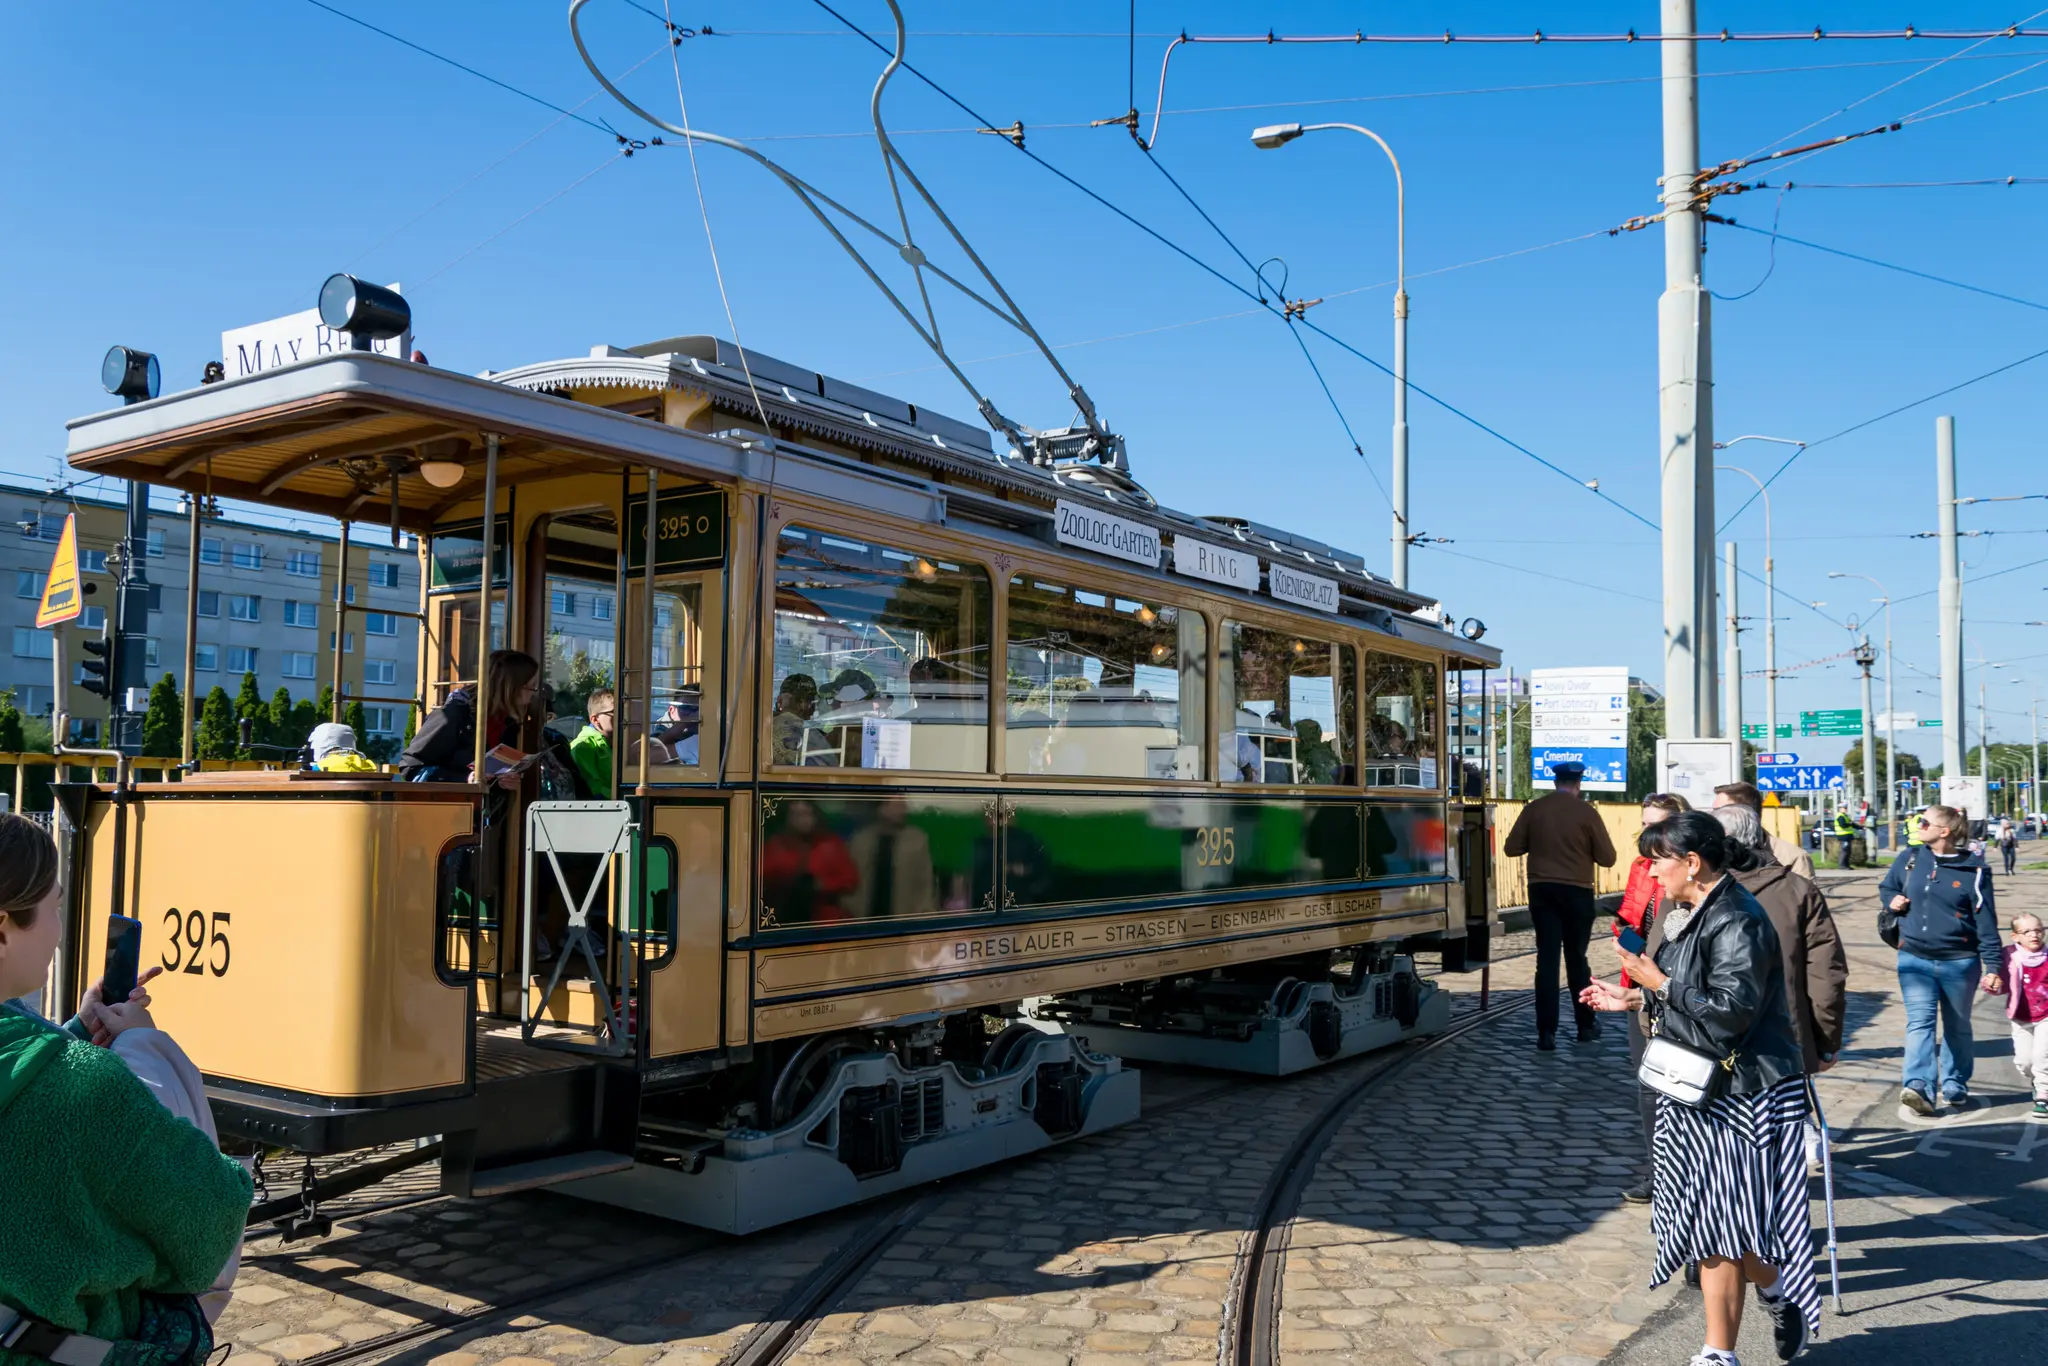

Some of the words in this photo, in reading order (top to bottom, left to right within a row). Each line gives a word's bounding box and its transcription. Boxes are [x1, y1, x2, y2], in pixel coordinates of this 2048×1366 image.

[659, 516, 690, 540] 395
[1199, 546, 1238, 579] RING
[1275, 569, 1333, 606] KOENIGSPLATZ
[1543, 750, 1583, 762] Cmentarz
[1196, 826, 1235, 866] 395
[162, 907, 230, 977] 395
[955, 931, 1075, 960] BRESLAUER
[1105, 919, 1187, 942] STRASSEN
[1211, 908, 1285, 929] EISENBAHN
[1304, 898, 1383, 918] GESELLSCHAFT
